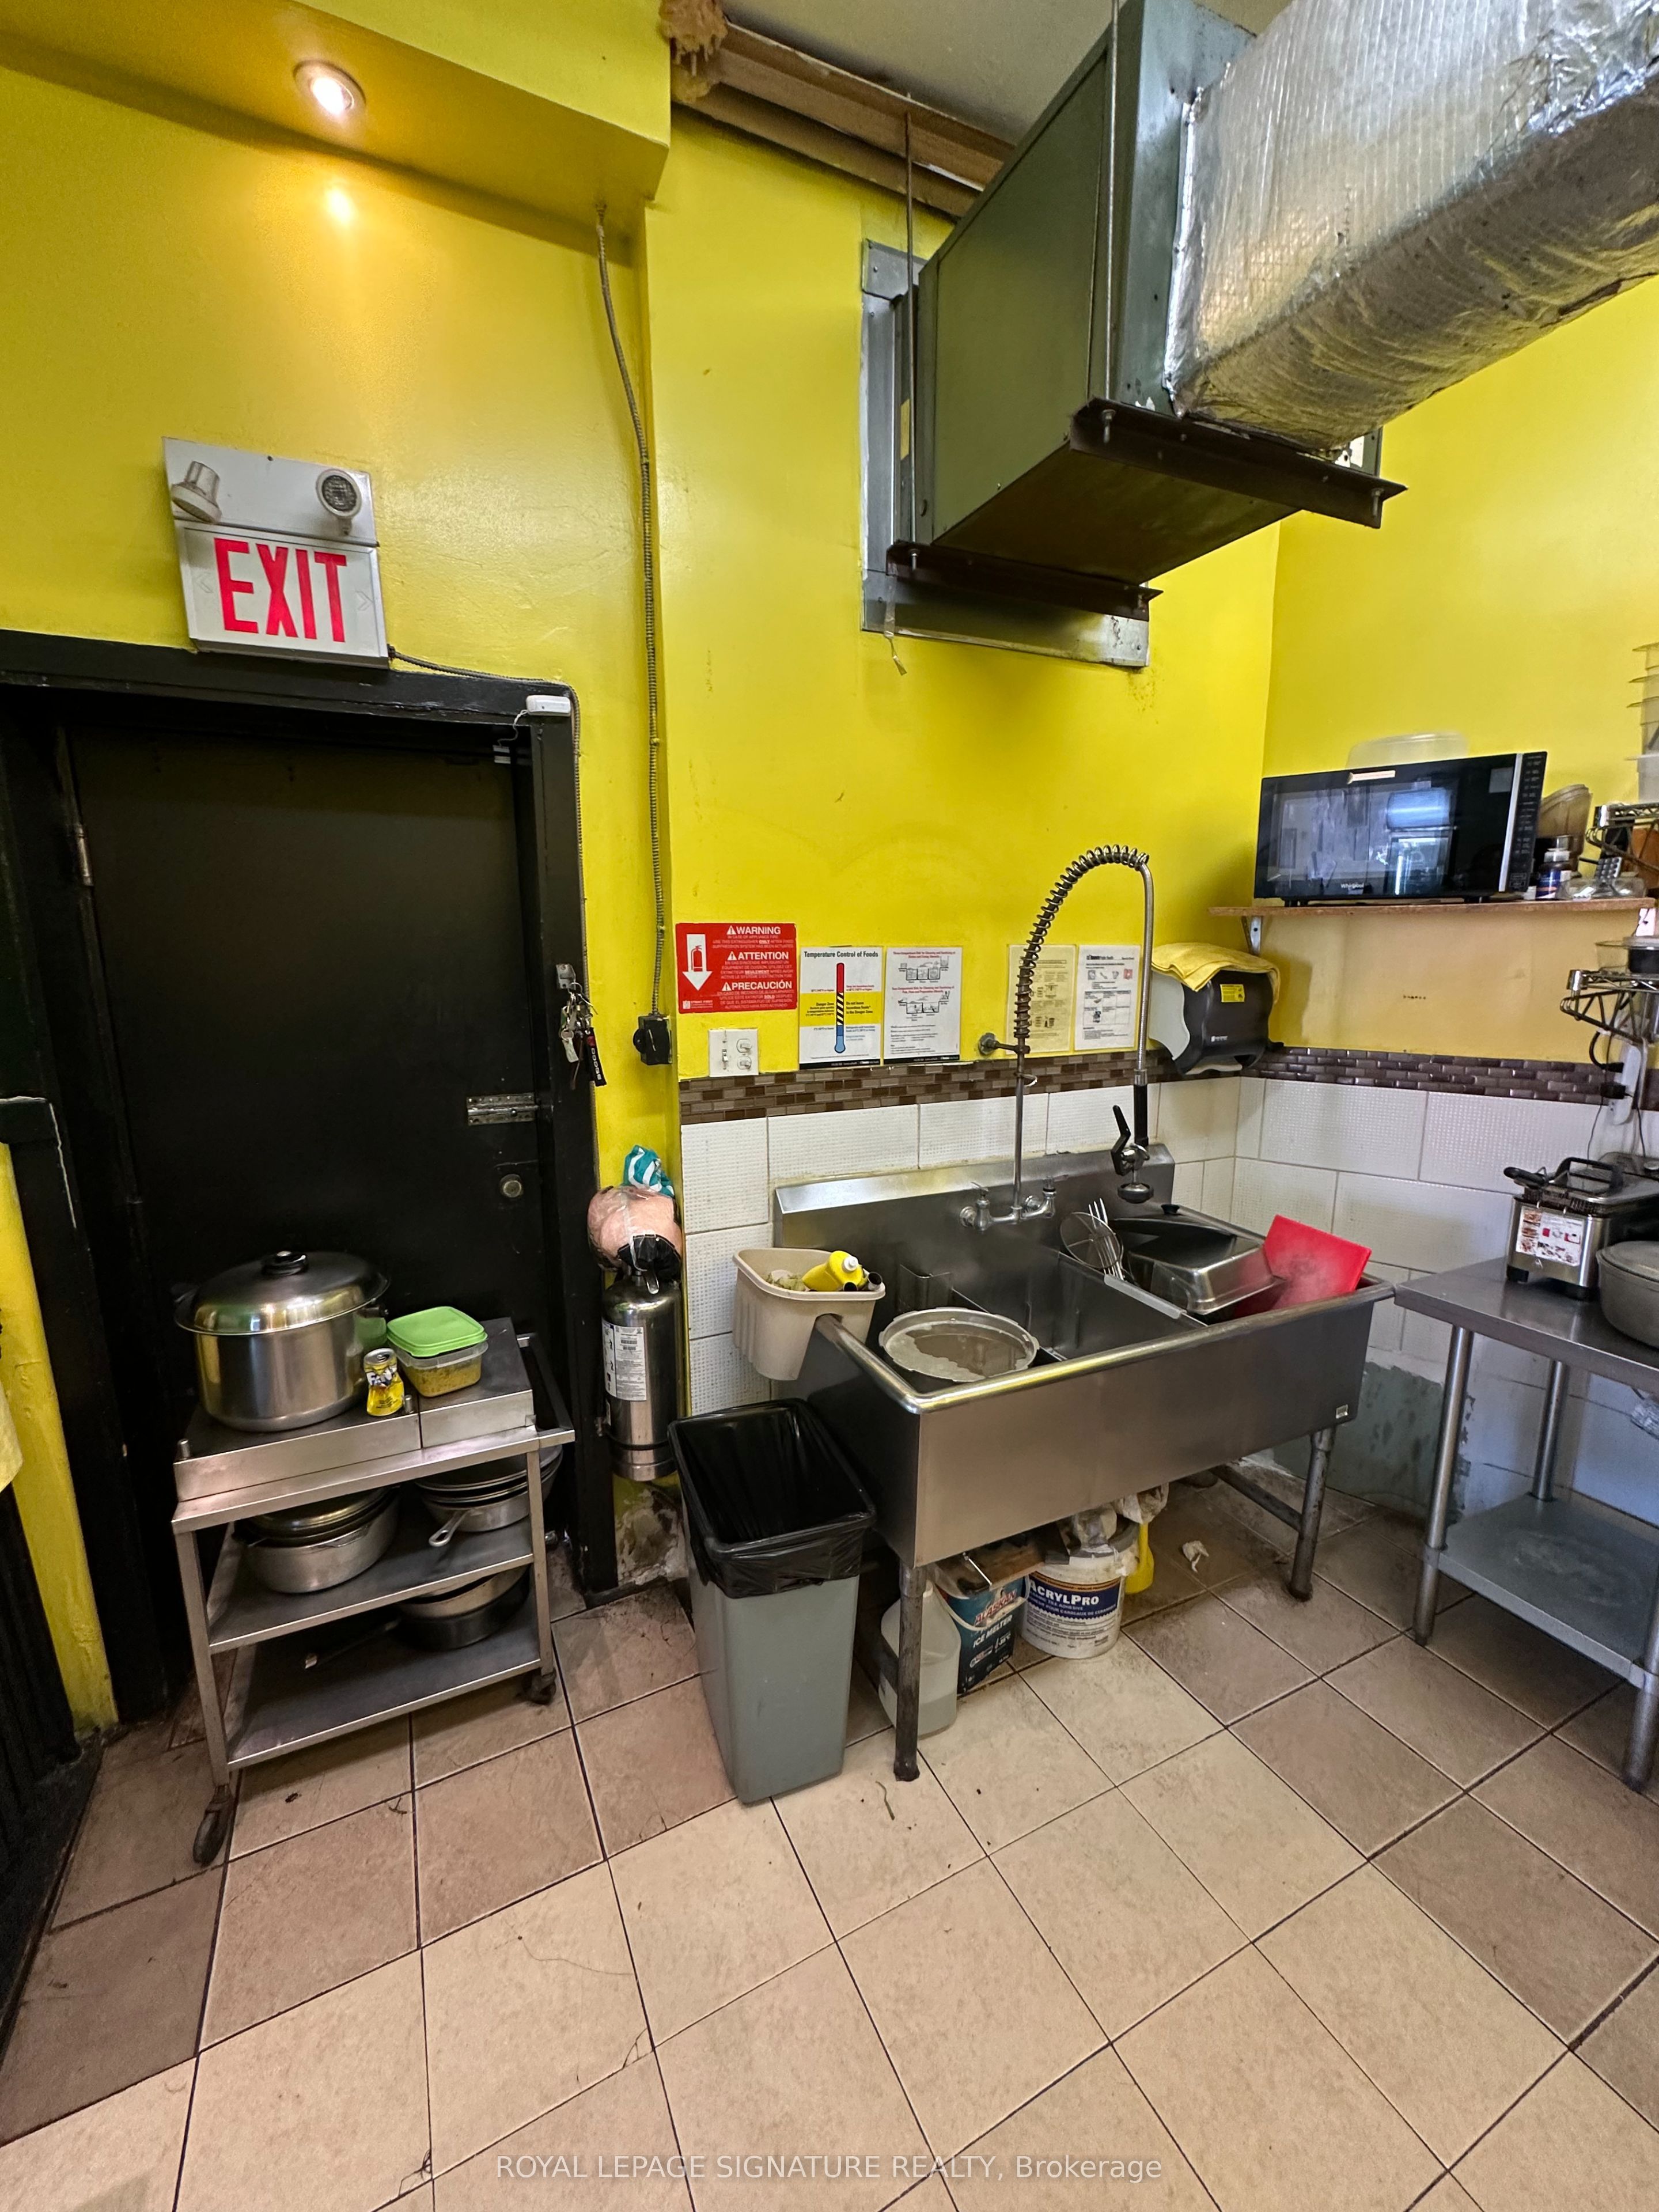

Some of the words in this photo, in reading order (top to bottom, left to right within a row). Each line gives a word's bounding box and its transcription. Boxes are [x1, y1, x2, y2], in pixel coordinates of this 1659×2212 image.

[214, 537, 347, 642] EXIT
[736, 926, 781, 935] WARNING
[738, 952, 789, 960] ATTENTION
[732, 980, 792, 990] PRECAUCIÓN
[973, 1633, 986, 1649] ICE
[986, 1614, 1013, 1639] MELTER
